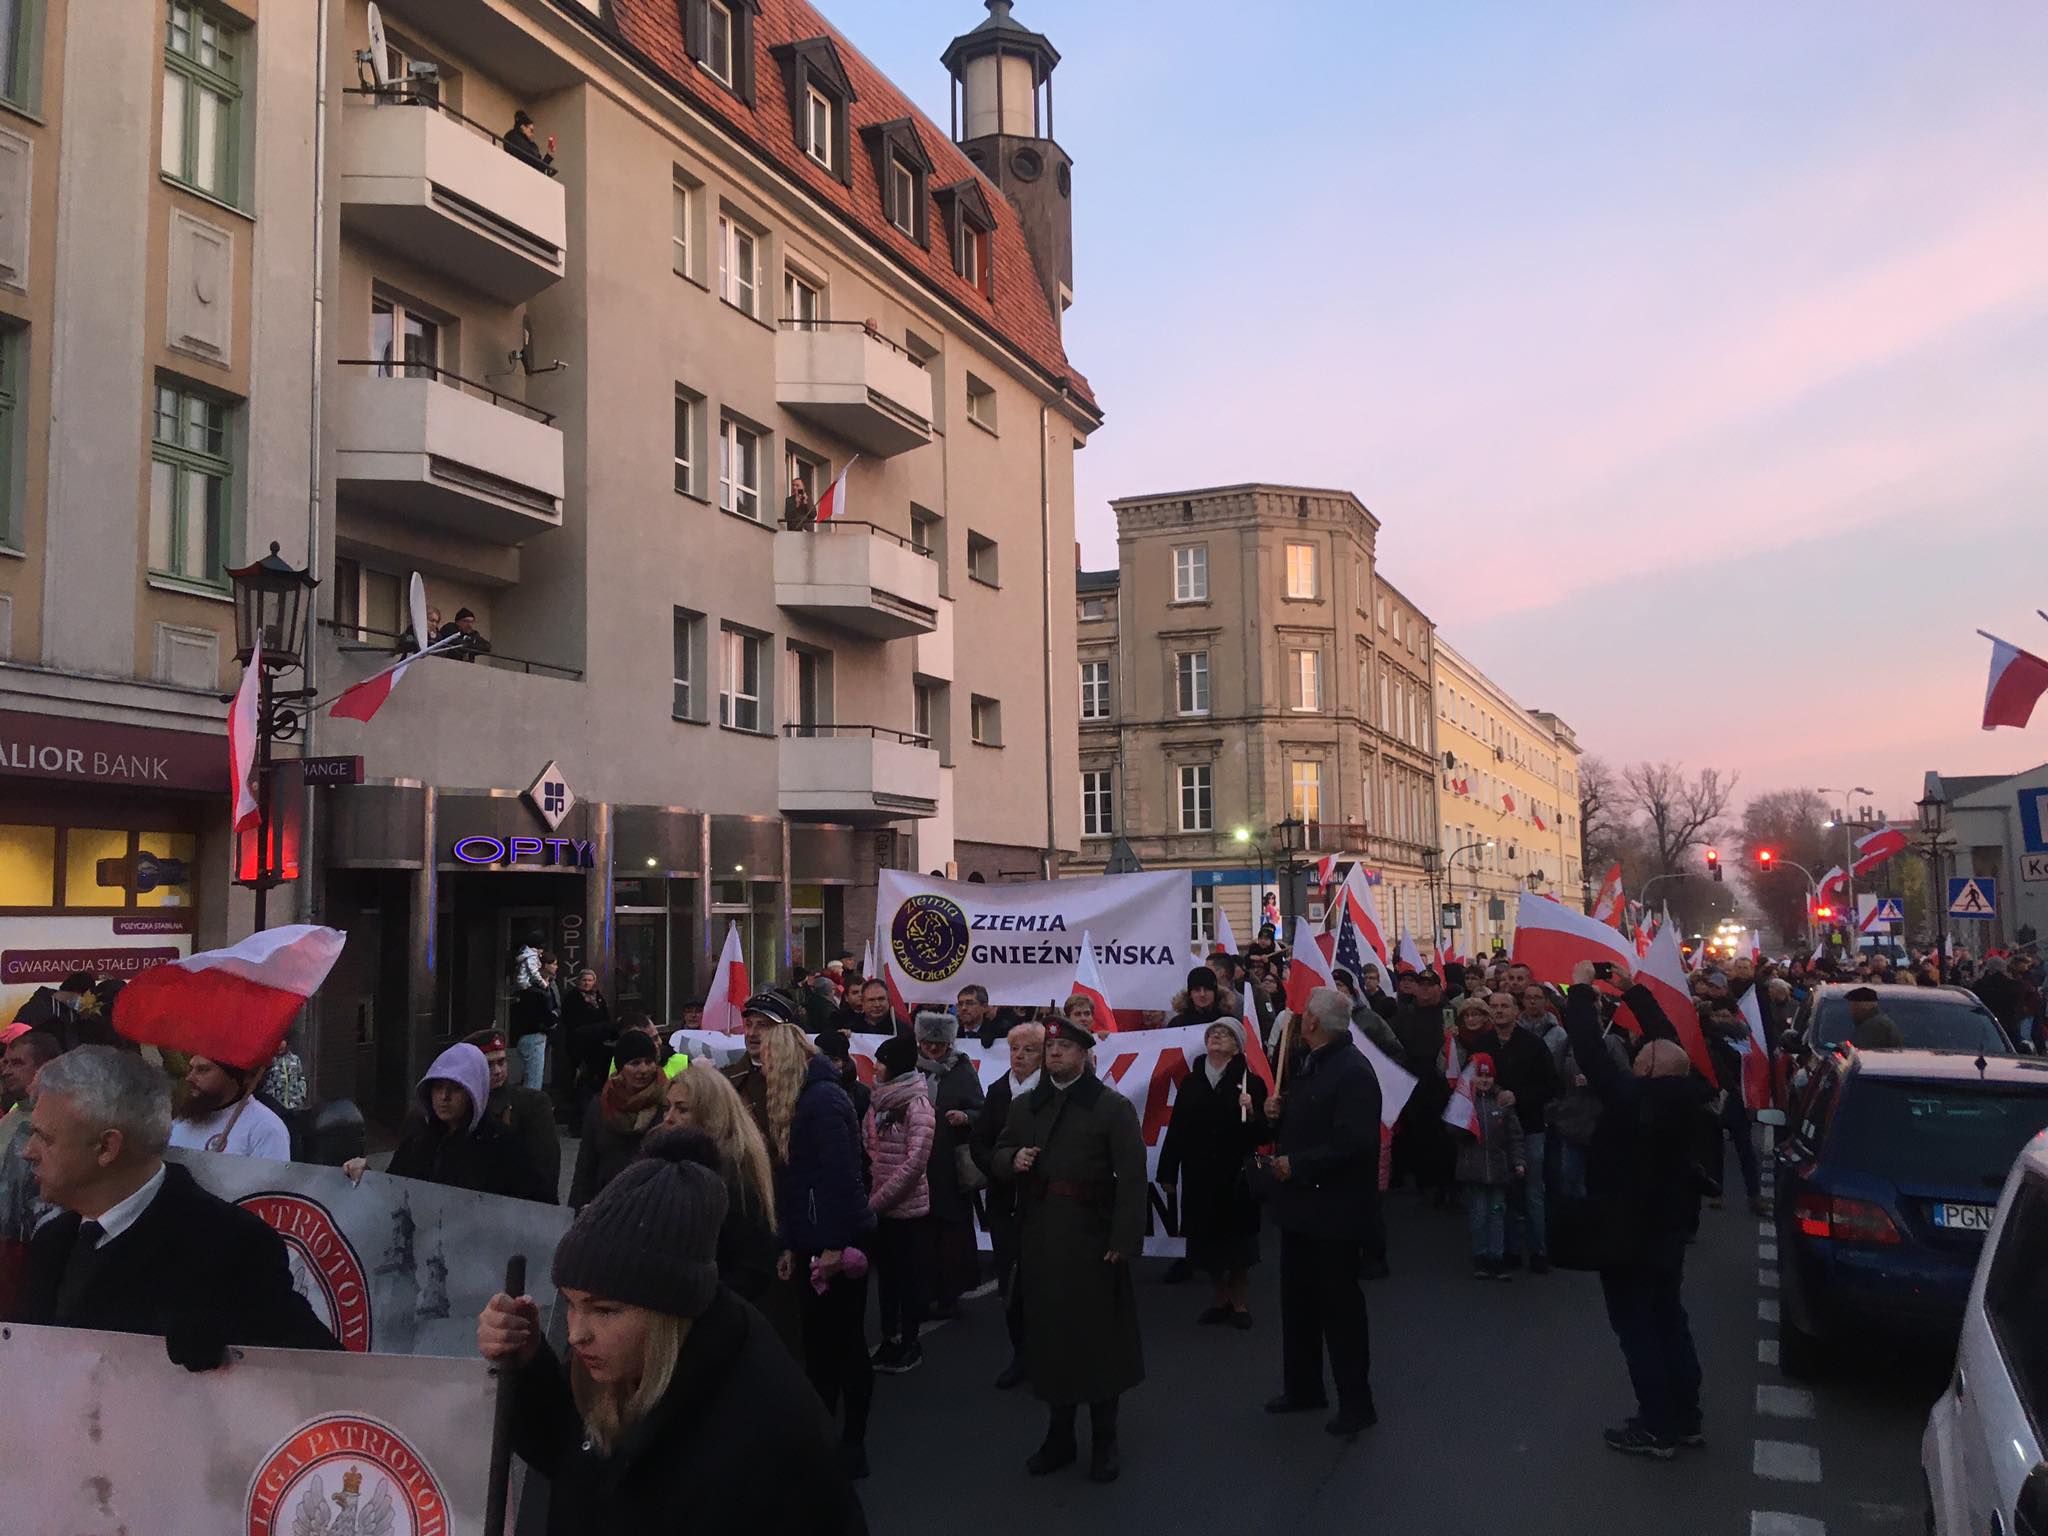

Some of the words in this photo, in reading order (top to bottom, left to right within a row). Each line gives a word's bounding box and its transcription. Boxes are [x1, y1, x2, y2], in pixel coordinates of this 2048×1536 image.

[93, 751, 169, 781] BANK
[905, 897, 959, 917] ziemia
[971, 914, 1067, 932] ZIEMIA
[562, 914, 583, 990] OPTYK
[8, 959, 95, 974] GWARANCJA
[97, 957, 139, 971] STAŁEJ
[143, 957, 168, 969] RAT
[254, 1452, 303, 1527] LIGA
